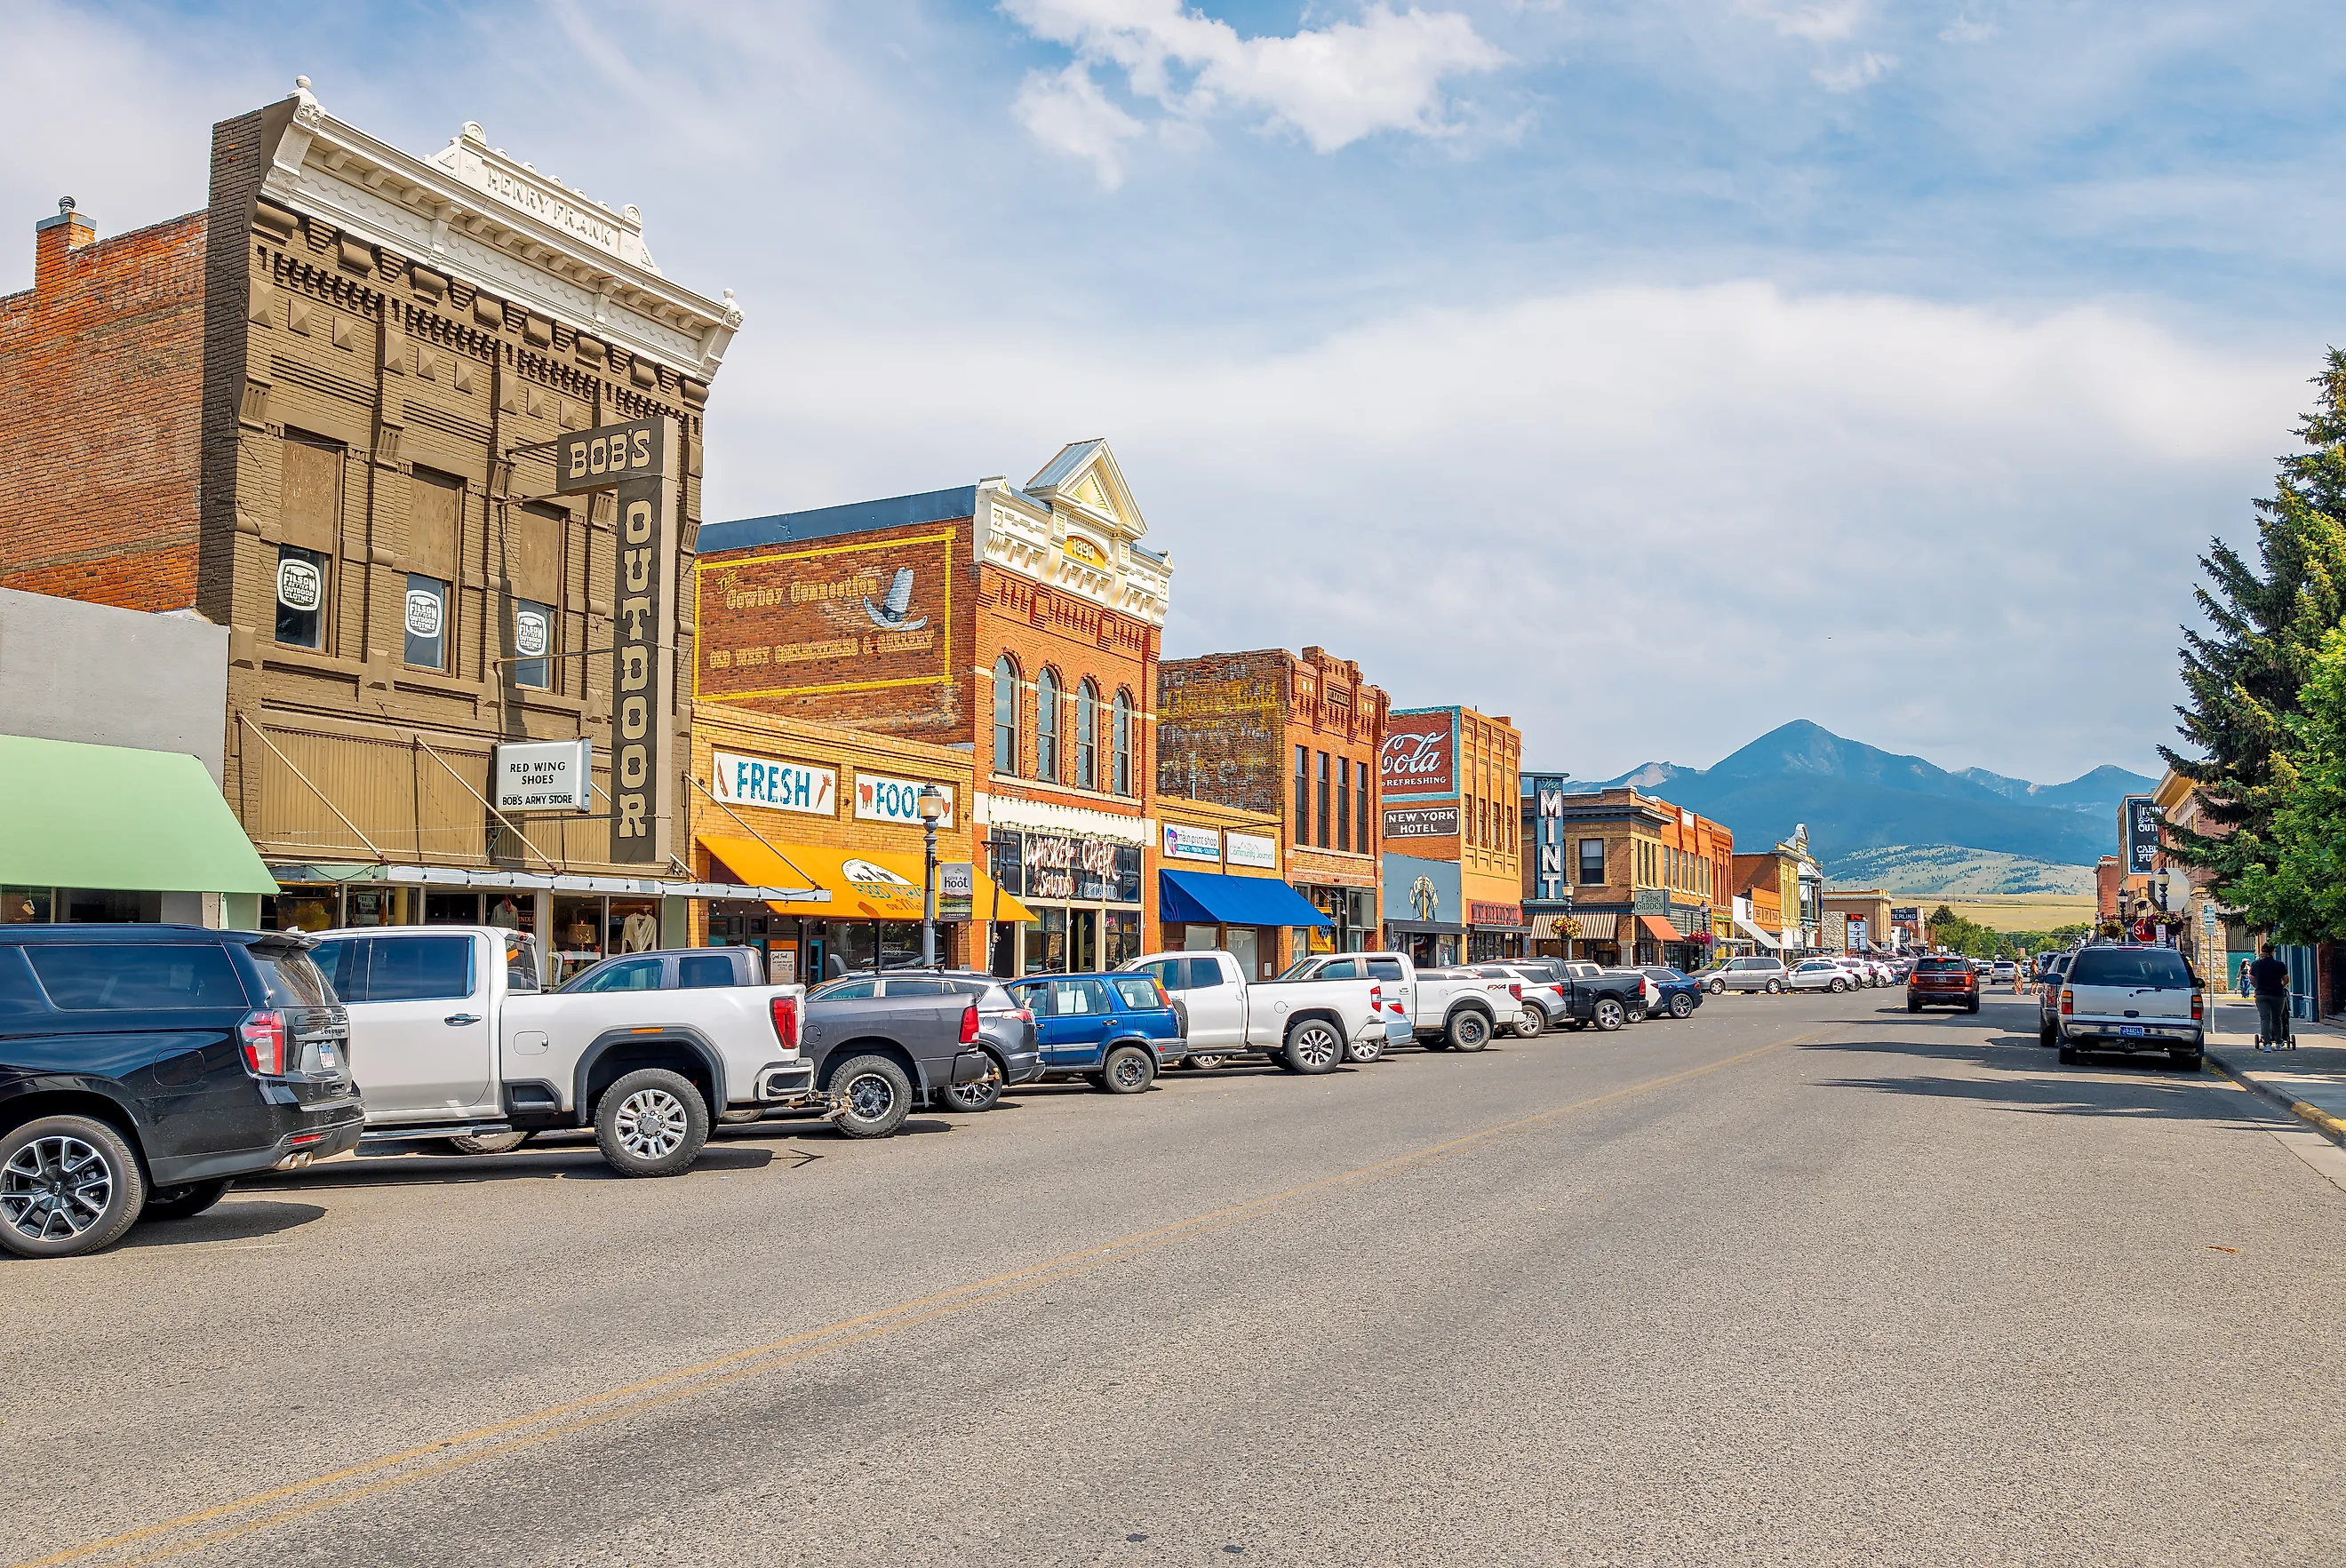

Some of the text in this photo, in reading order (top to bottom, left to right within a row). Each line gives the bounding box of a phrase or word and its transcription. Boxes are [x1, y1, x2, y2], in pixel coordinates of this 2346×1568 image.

[488, 167, 612, 247] HENRY FRANK
[569, 427, 651, 480] BOB'S
[283, 573, 316, 592] FILSON
[718, 571, 739, 591] THE
[283, 585, 315, 597] OUTDOOR
[284, 592, 315, 603] CLOTHES
[726, 576, 879, 610] Cowboy Connection
[410, 603, 437, 620] FILSON
[410, 615, 436, 625] OUTDOOR
[411, 620, 436, 630] CLOTHES
[519, 624, 543, 639] FILSON
[709, 629, 936, 668] OLD WEST COLLECTIBLES & GALLERY
[618, 499, 655, 839] OUTDOOR
[1381, 730, 1448, 775] Cola
[510, 761, 566, 773] RED WING
[521, 774, 555, 785] SHOES
[738, 761, 810, 808] FRESH
[1386, 776, 1447, 786] REFRESHING
[502, 794, 572, 806] BOB'S ARMY STORE
[1388, 810, 1456, 824] NEW YORK
[1400, 824, 1438, 834] HOTEL
[1540, 790, 1562, 900] MINT
[944, 876, 969, 888] hoot
[1408, 875, 1439, 909] COFFEE
[1635, 900, 1664, 911] GARDEN
